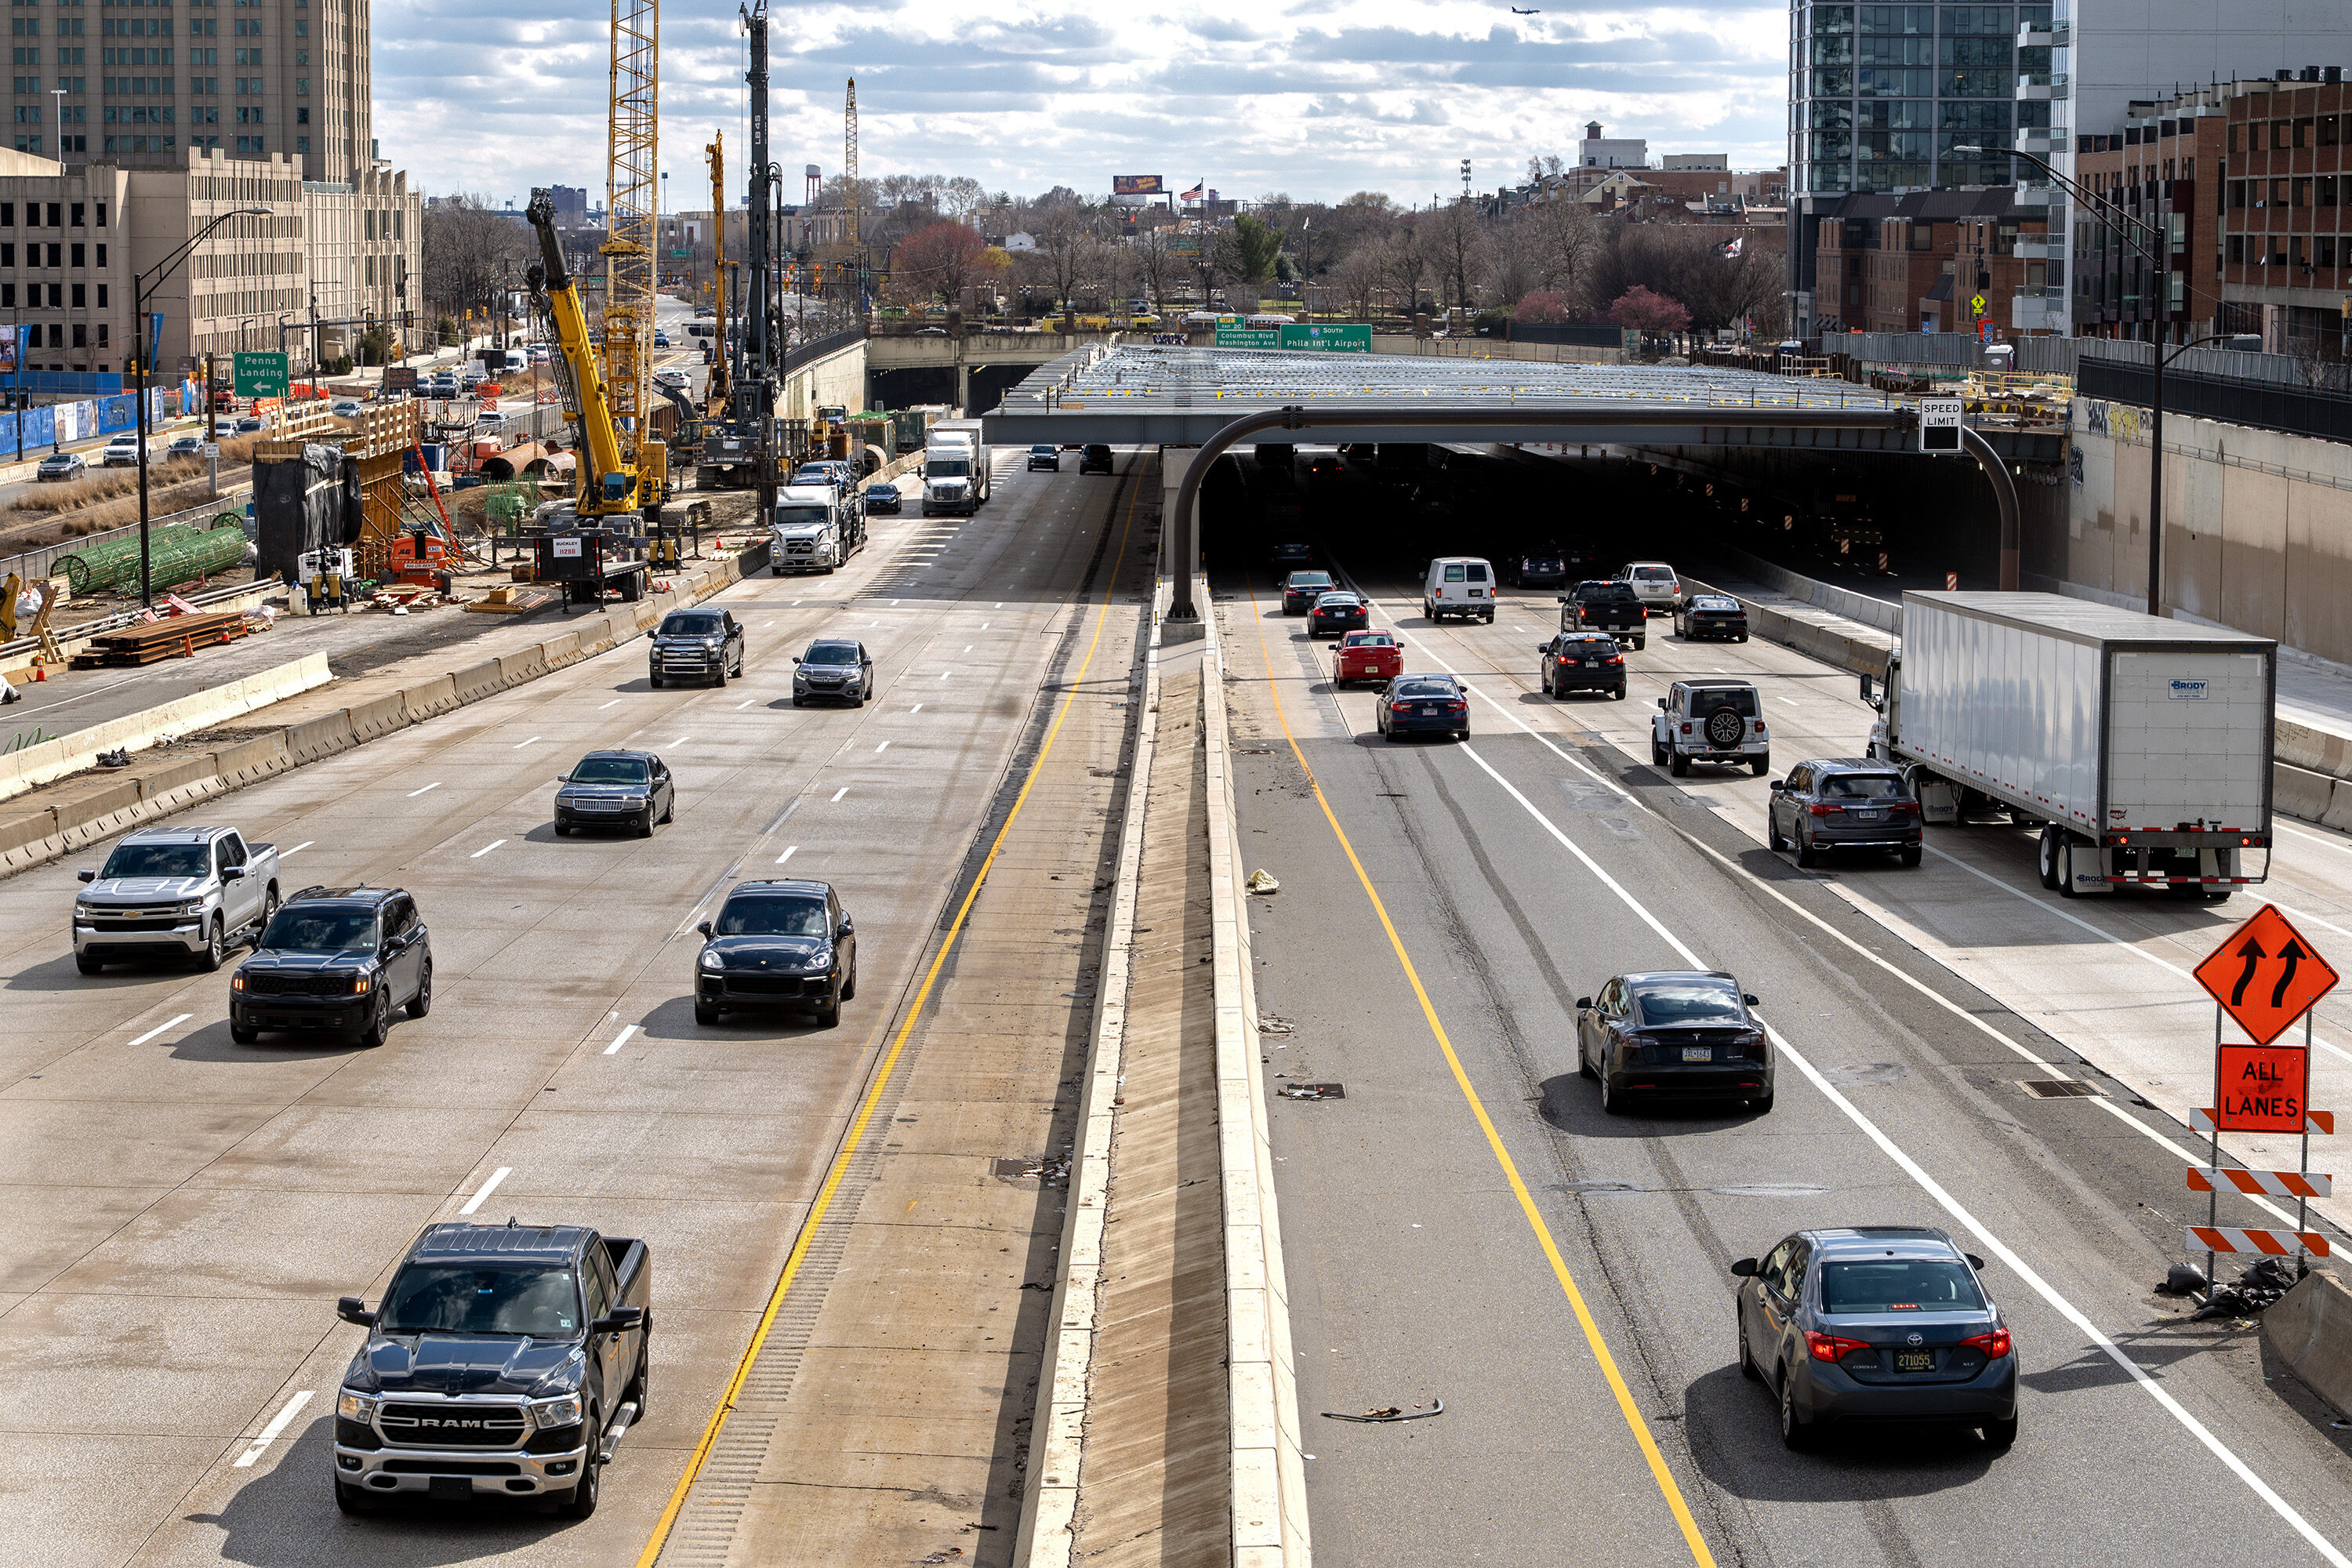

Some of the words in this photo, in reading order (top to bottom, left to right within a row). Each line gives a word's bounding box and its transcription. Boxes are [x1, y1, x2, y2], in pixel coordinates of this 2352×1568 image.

[1334, 339, 1366, 348] Airport
[240, 368, 283, 379] Landing
[2171, 681, 2206, 689] BRODY
[2076, 874, 2105, 883] BROD
[2242, 1062, 2284, 1081] ALL
[2225, 1098, 2298, 1118] LANES
[1898, 1355, 1931, 1367] 271055
[421, 1418, 481, 1428] RAM
